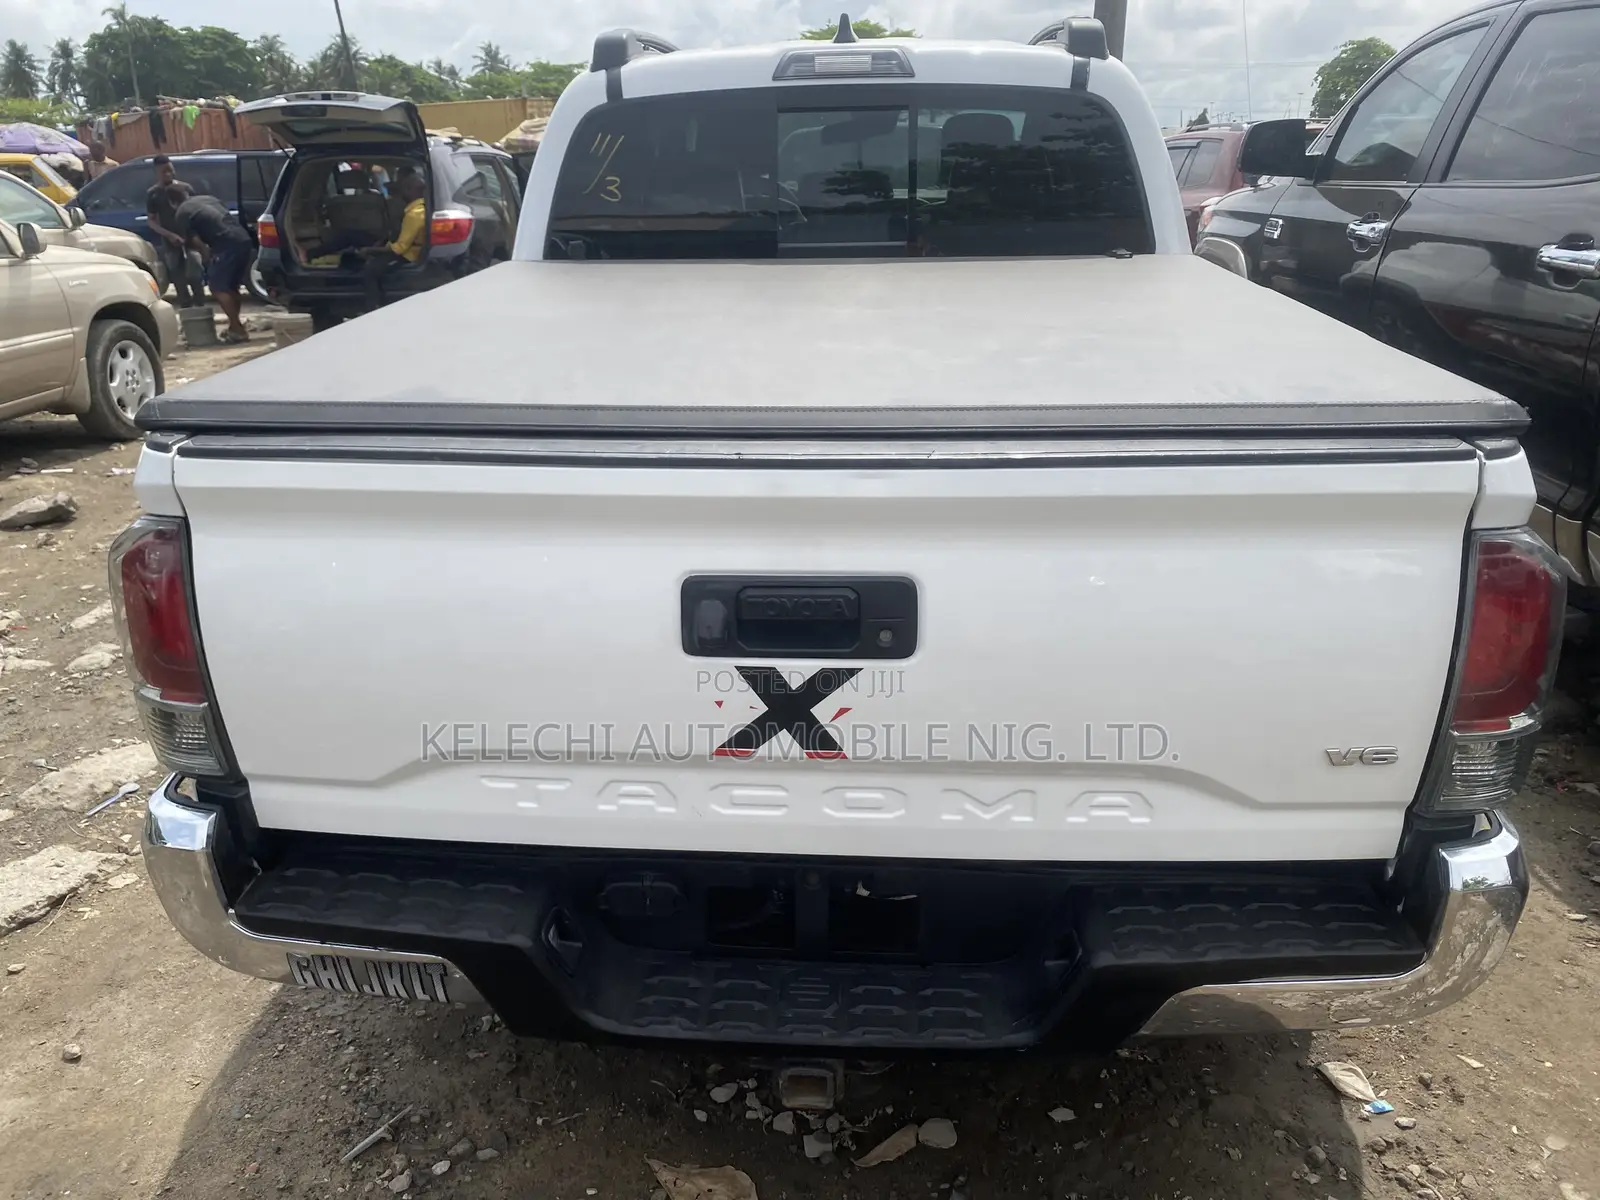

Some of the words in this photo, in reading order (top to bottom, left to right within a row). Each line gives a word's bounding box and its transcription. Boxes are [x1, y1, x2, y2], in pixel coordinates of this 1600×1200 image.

[746, 597, 850, 617] TOYOTA
[711, 665, 864, 760] X
[1325, 745, 1399, 767] V6
[478, 774, 1154, 823] TACOMA
